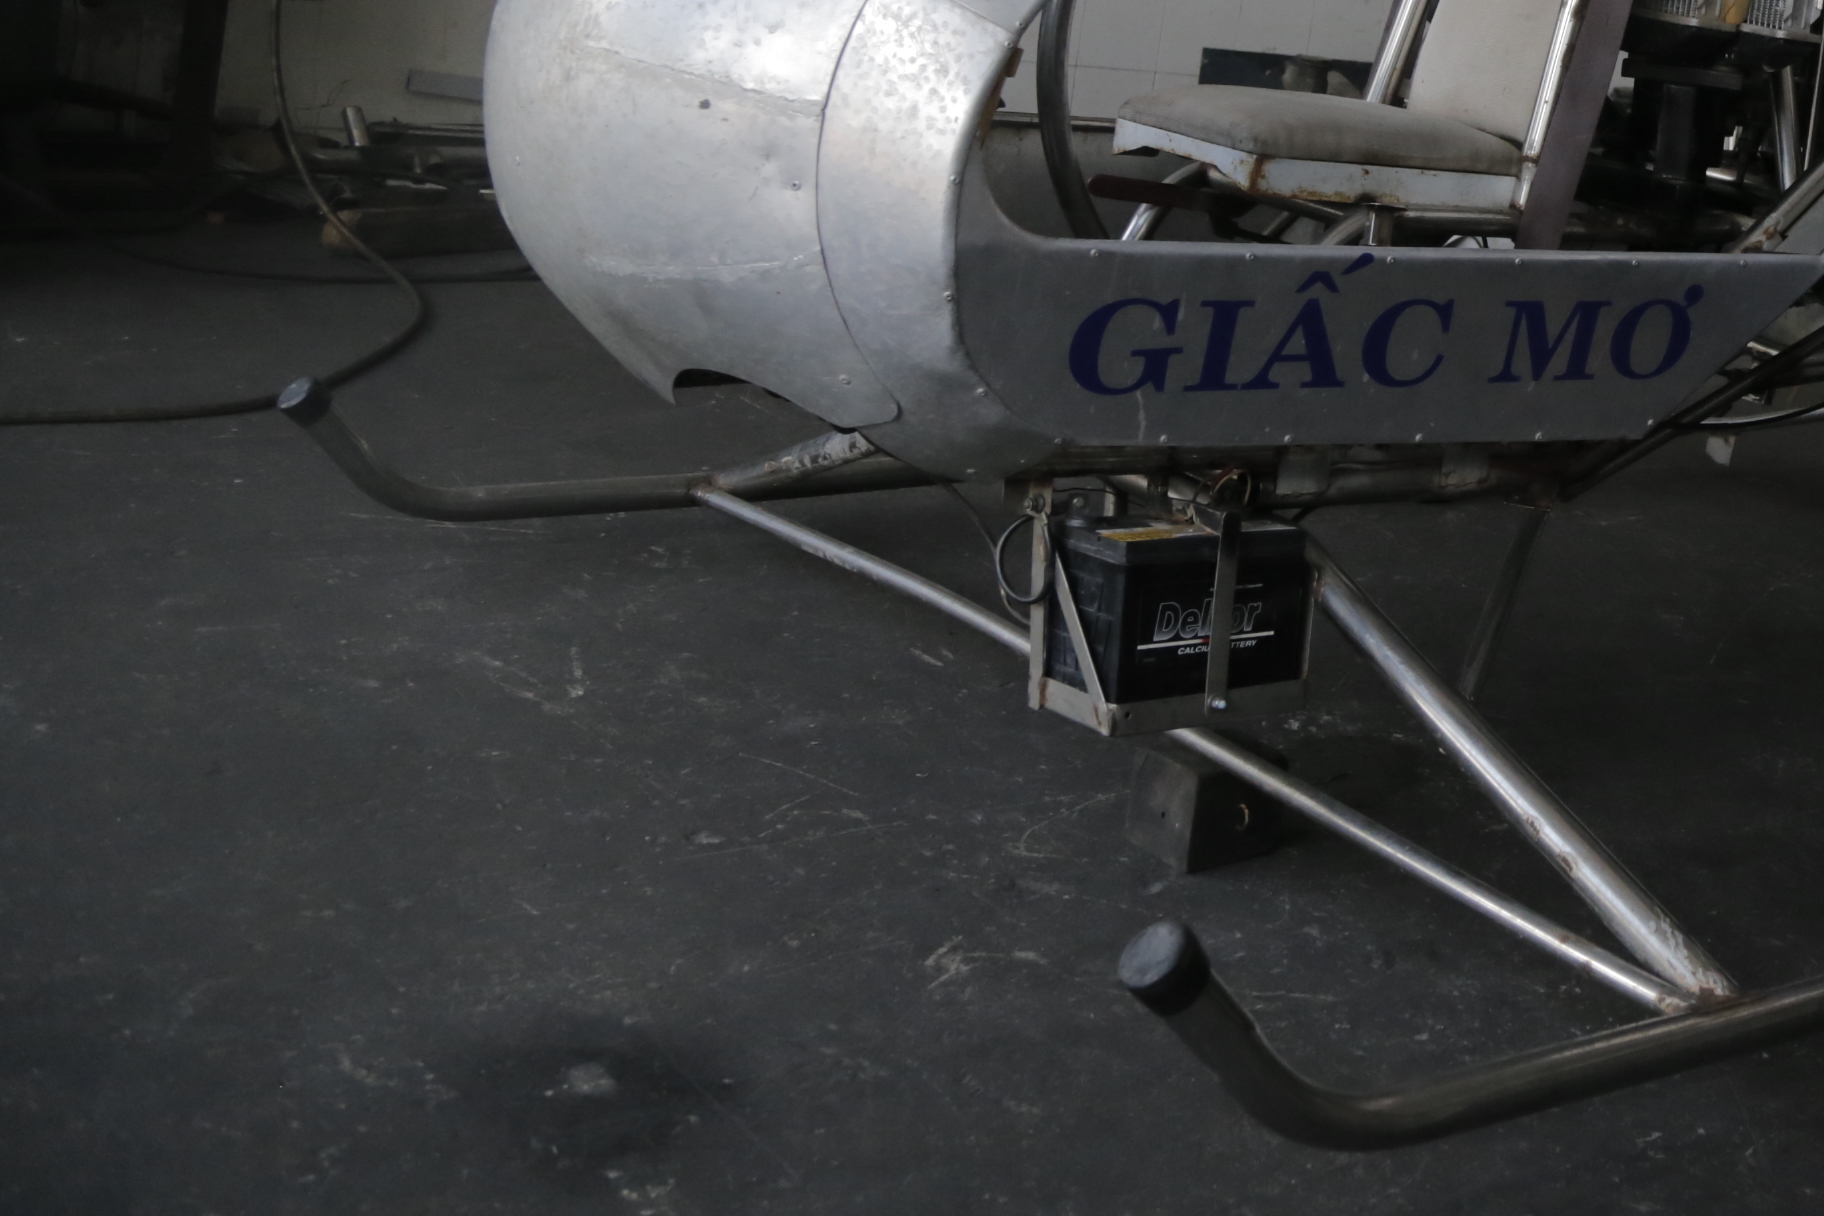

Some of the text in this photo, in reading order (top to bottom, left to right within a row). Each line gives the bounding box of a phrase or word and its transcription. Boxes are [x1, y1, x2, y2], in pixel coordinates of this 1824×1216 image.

[1068, 252, 1705, 397] GIẤC MƠ
[1153, 597, 1262, 642] Delor
[1177, 639, 1258, 656] CALCIU TTERY
